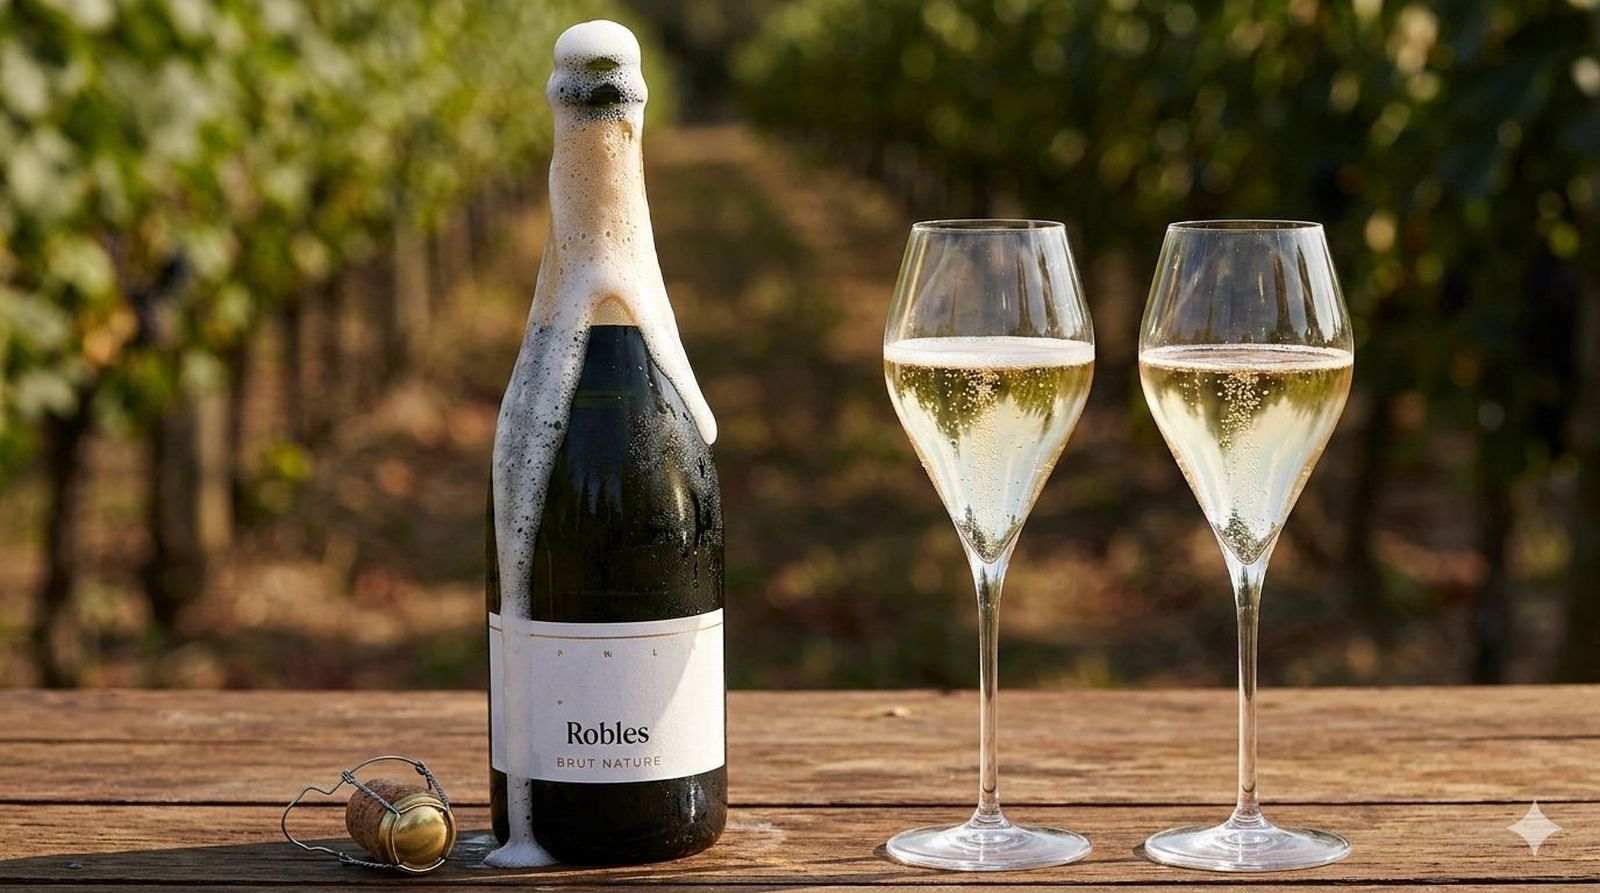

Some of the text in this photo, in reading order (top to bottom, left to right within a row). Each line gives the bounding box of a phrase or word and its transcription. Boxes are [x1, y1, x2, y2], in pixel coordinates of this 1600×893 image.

[566, 721, 650, 746] Robles
[556, 755, 662, 769] BRUT NATURE
